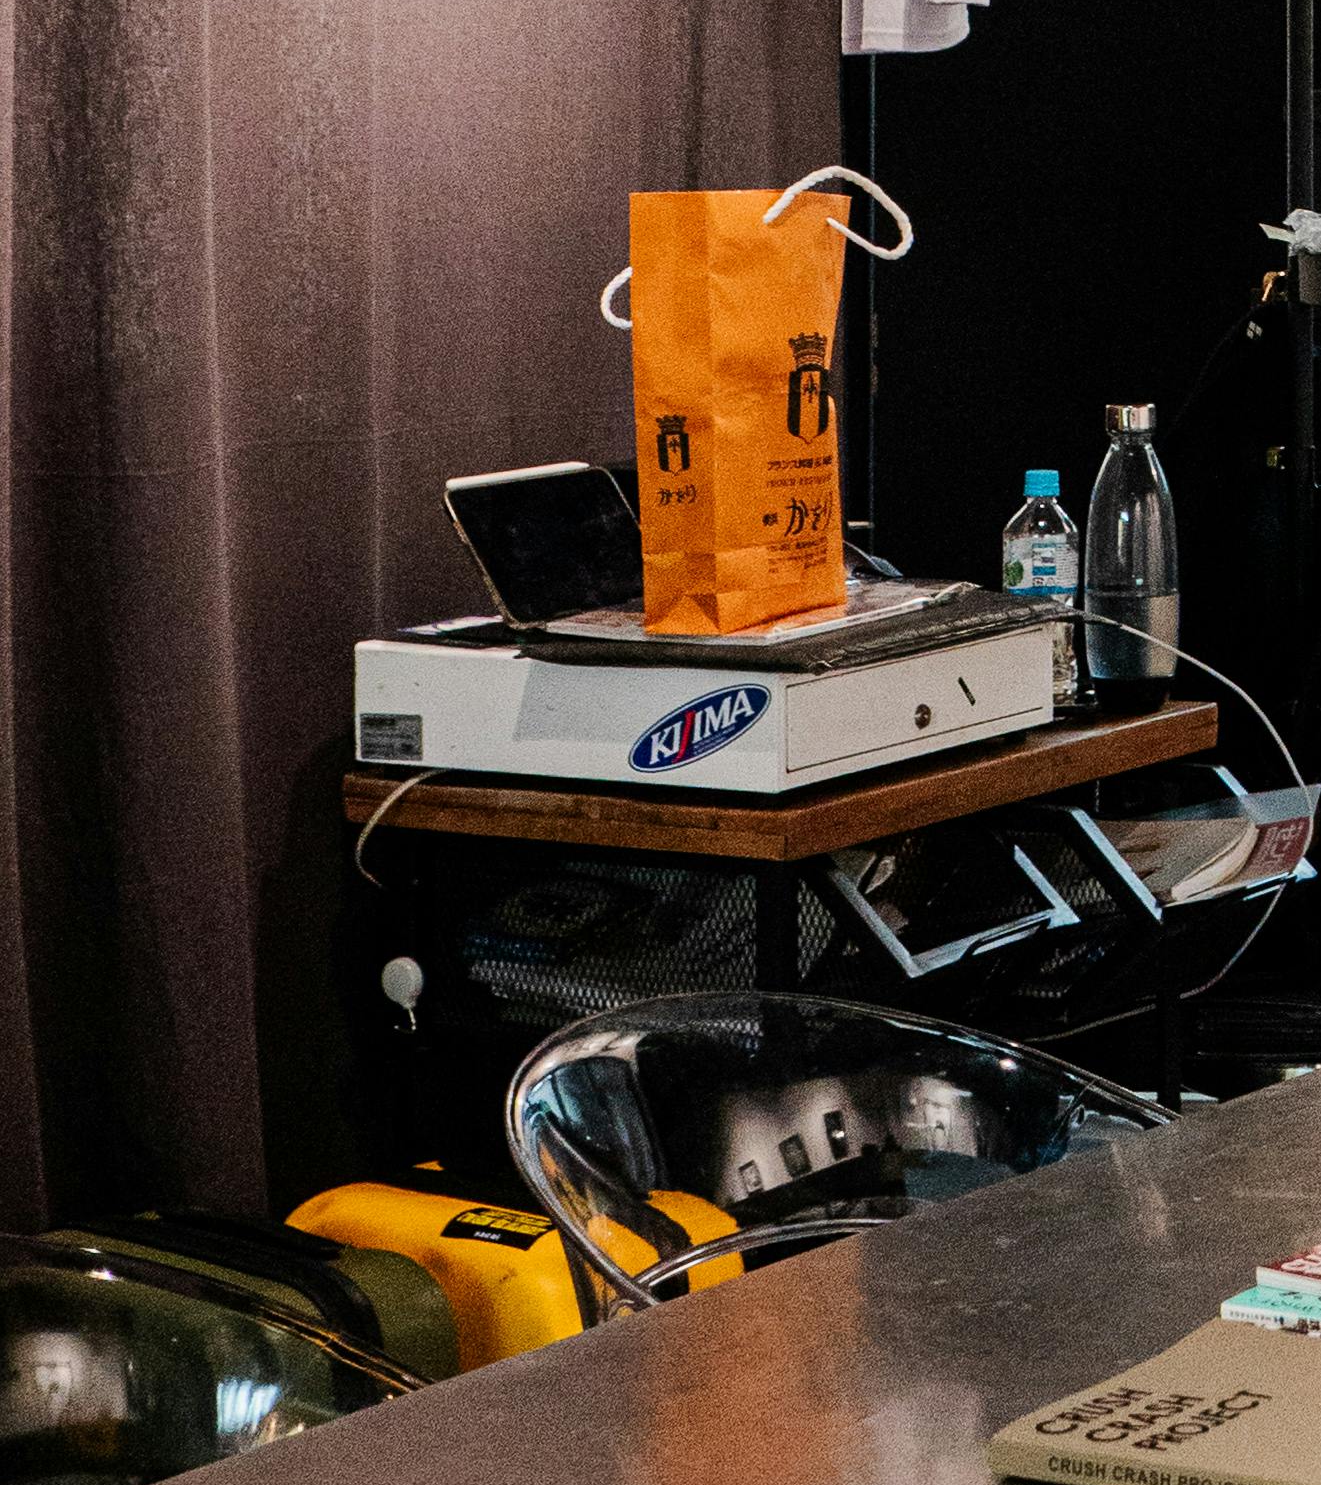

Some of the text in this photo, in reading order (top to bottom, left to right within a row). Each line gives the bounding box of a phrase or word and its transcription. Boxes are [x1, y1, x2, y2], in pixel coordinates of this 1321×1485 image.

[648, 689, 756, 766] KIJIMA
[1034, 1387, 1153, 1436] CRUSH
[1085, 1393, 1205, 1443] CRASH
[1132, 1390, 1273, 1451] PROJECT
[1047, 1455, 1107, 1481] CRUSH
